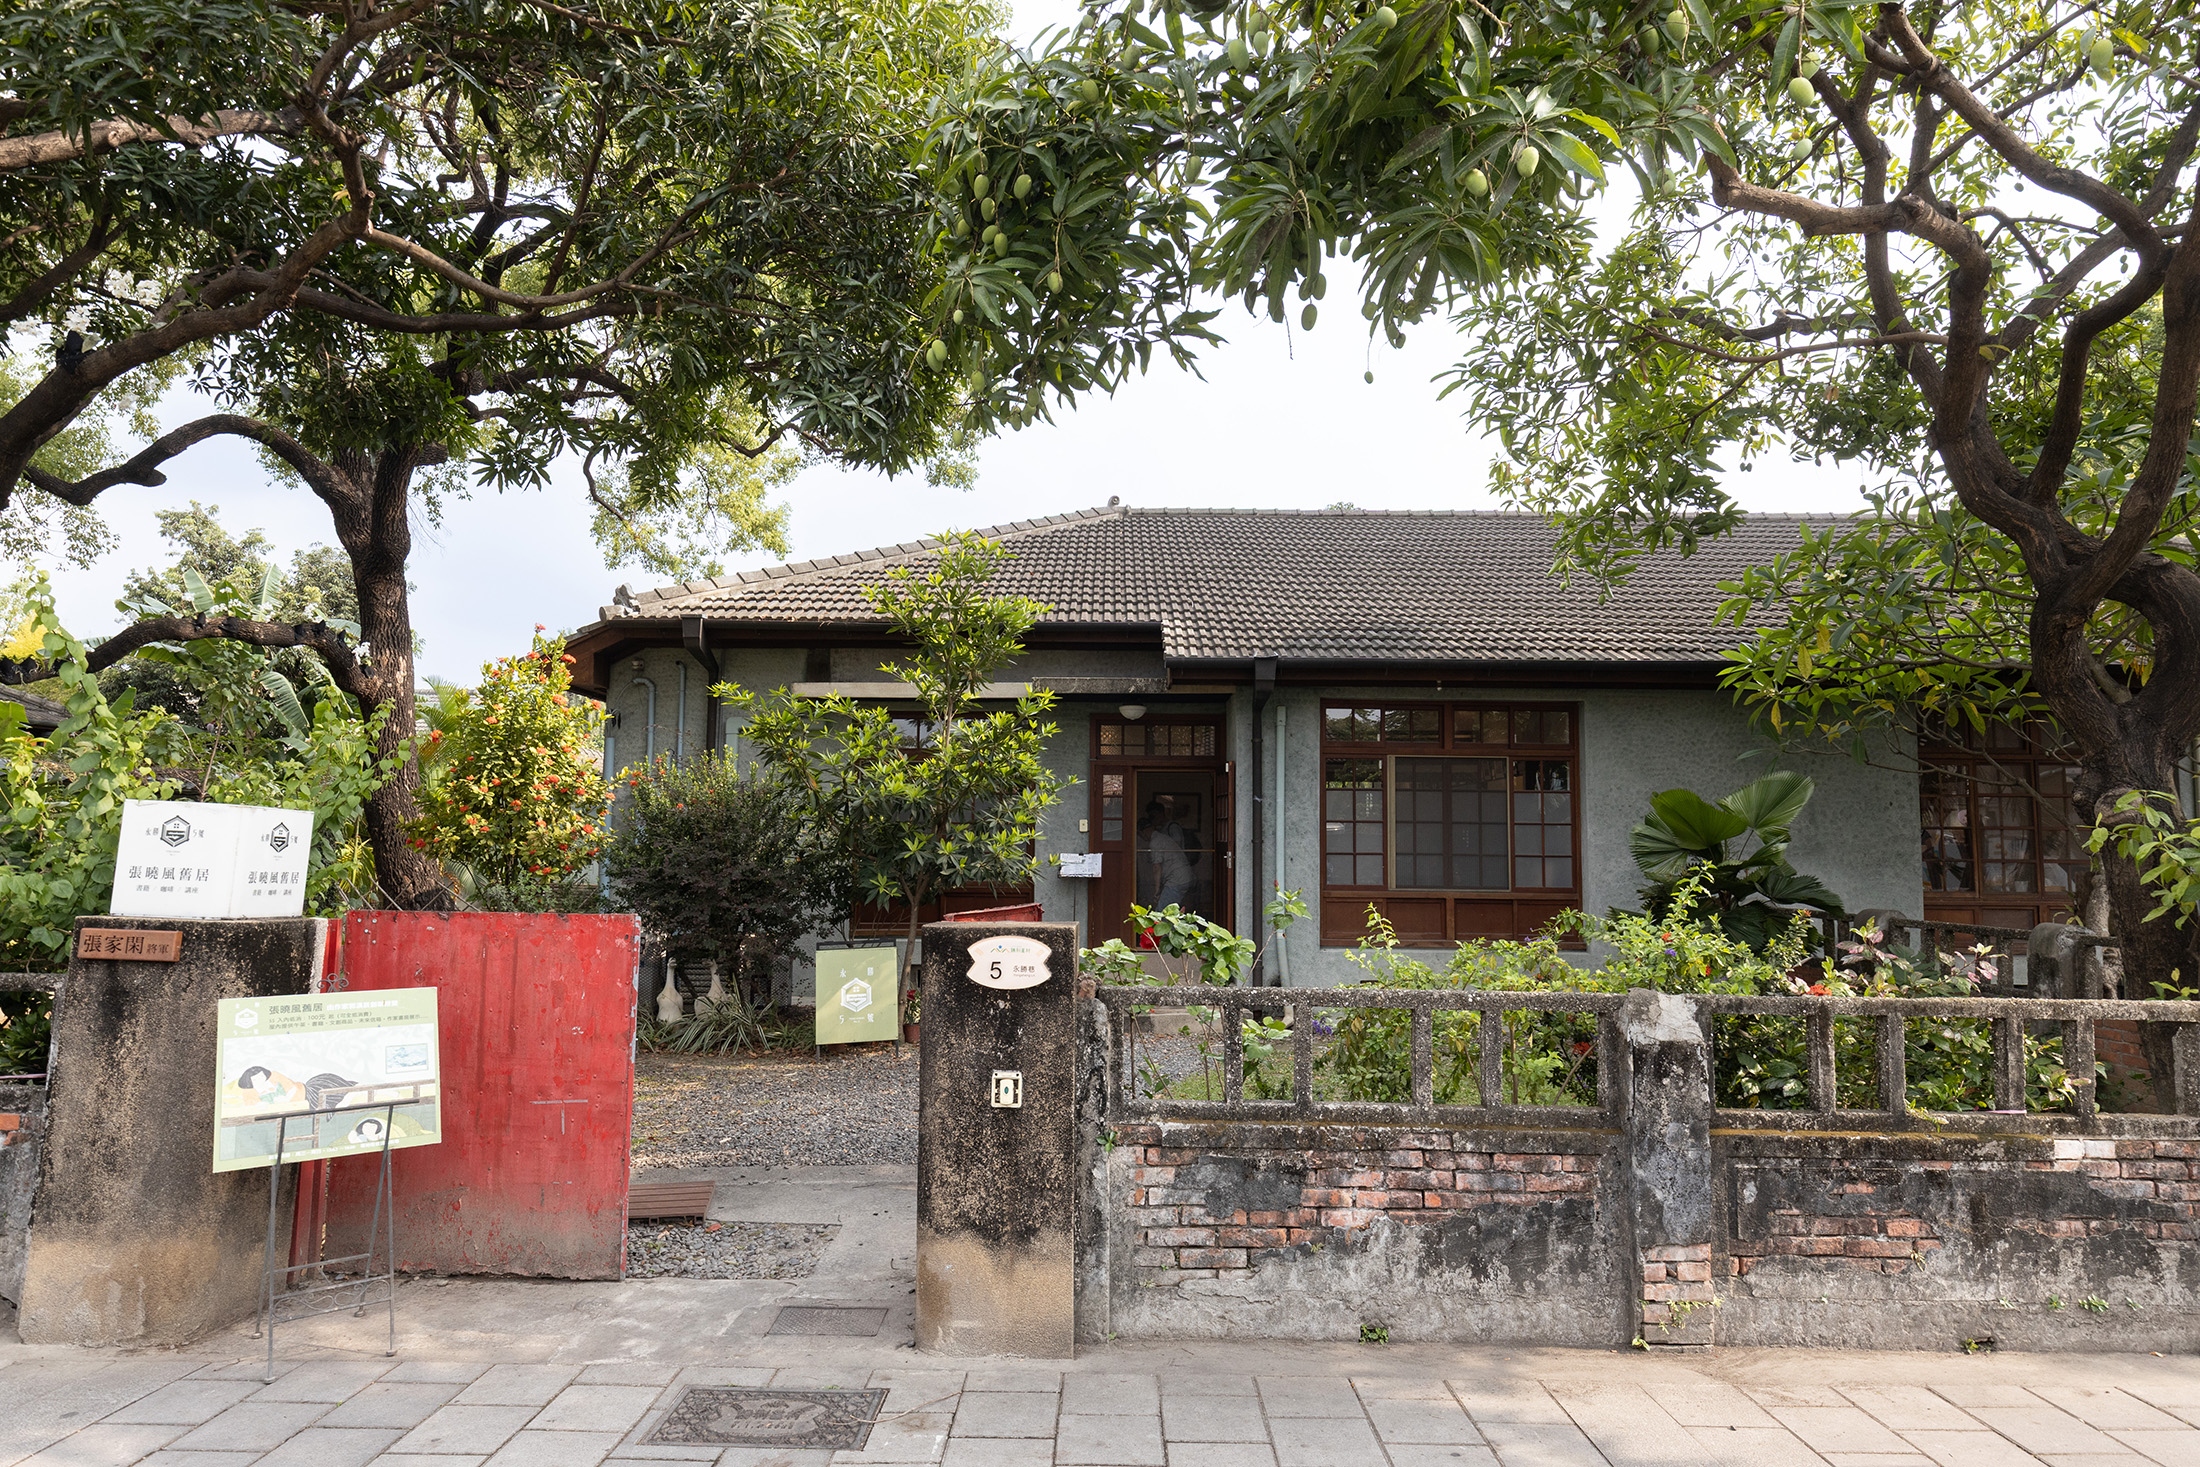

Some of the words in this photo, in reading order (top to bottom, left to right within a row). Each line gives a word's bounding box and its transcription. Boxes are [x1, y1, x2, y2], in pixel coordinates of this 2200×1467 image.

[129, 865, 209, 881] 張曉風舊居
[248, 871, 299, 884] 張曉風舊居
[83, 934, 145, 954] 張家閑
[146, 943, 170, 954] 將軍
[990, 961, 1002, 980] 5
[1013, 965, 1035, 973] 永勝巷
[269, 1002, 323, 1015] 張曉風舊居
